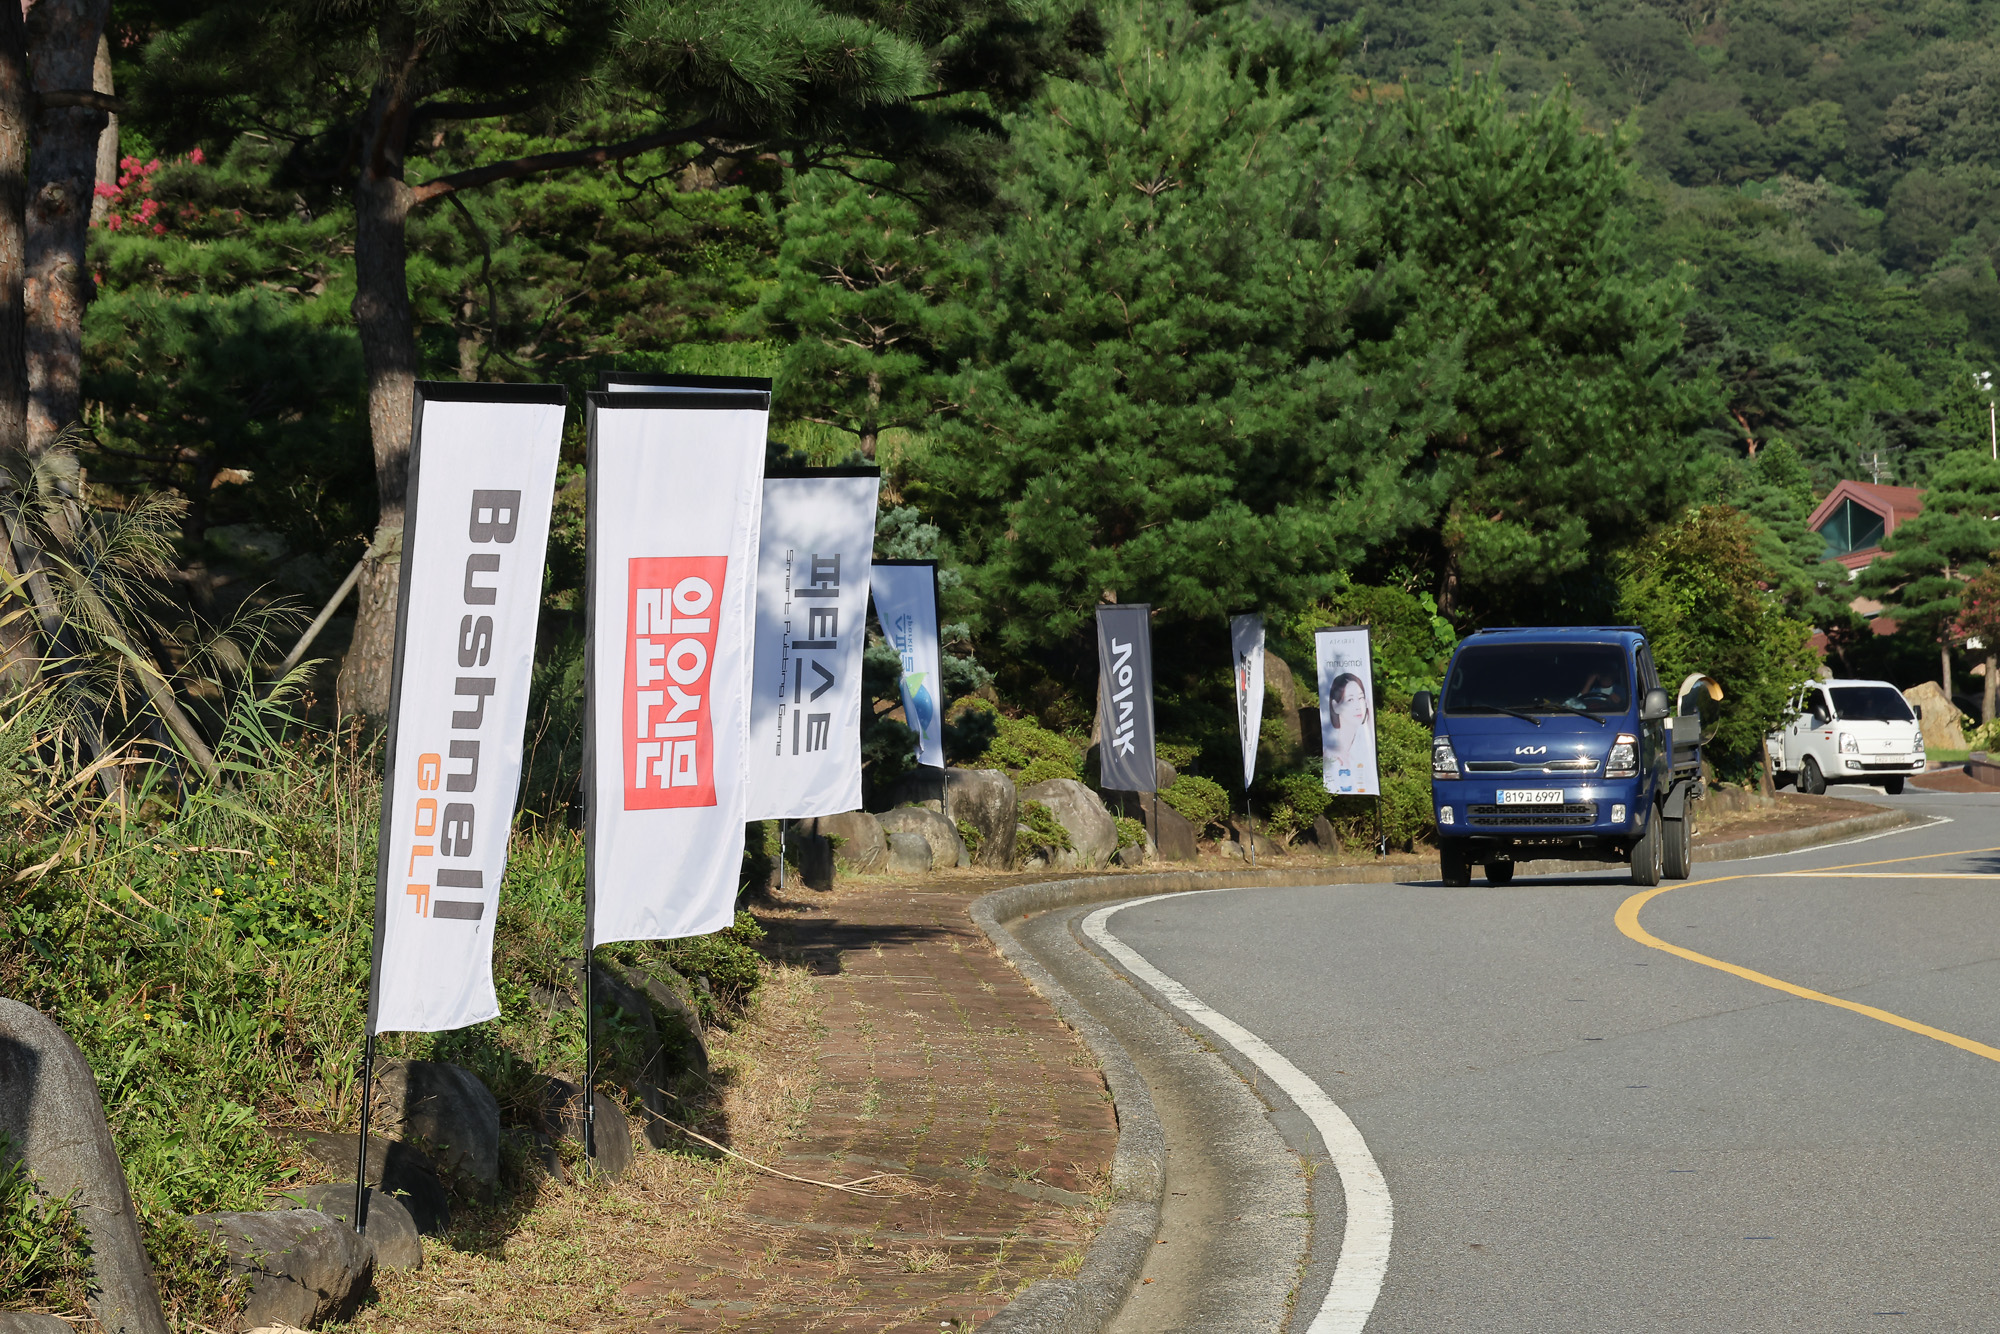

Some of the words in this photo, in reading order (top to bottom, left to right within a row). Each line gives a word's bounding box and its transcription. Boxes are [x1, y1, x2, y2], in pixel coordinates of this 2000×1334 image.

[779, 621, 791, 697] Putting
[786, 549, 794, 615] Smart
[791, 553, 841, 756] 퍼티스트
[432, 489, 521, 921] Bushnell
[635, 576, 714, 789] 일요신문
[775, 703, 786, 757] Game
[405, 753, 441, 918] GOLF
